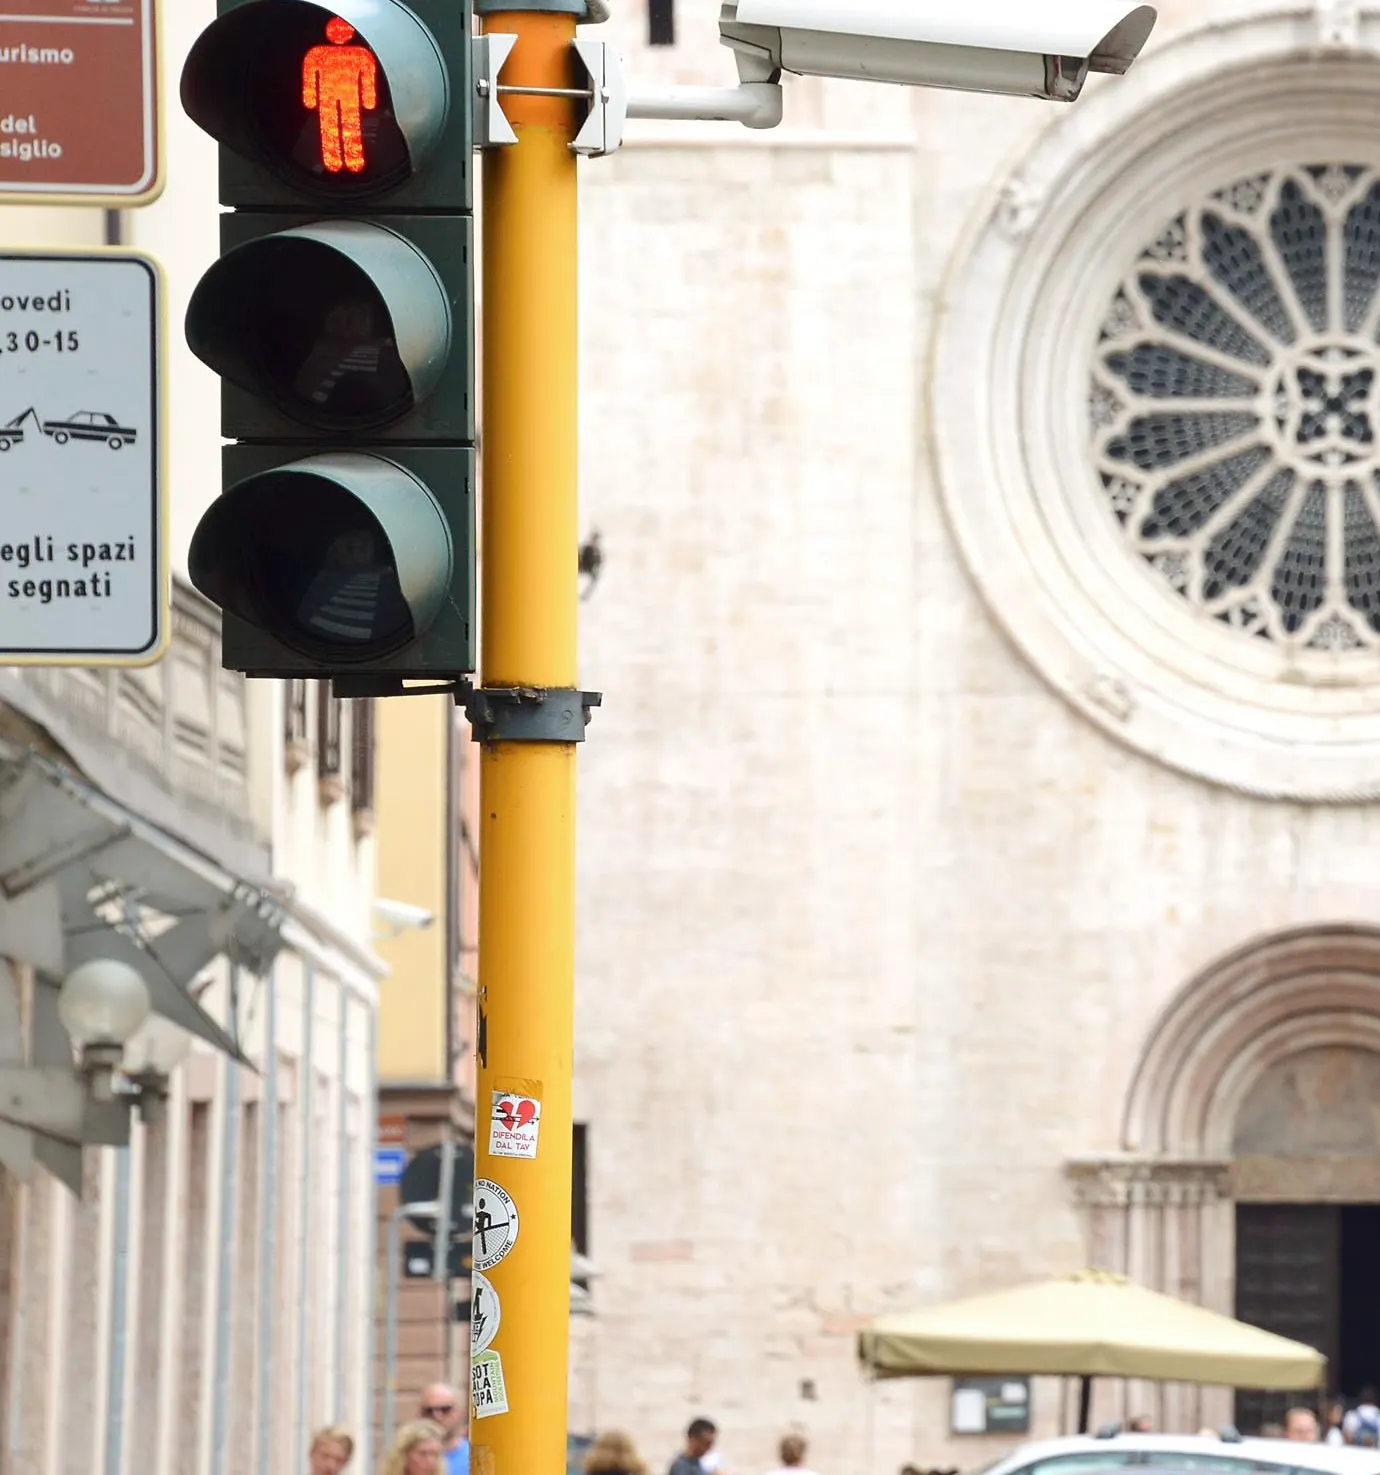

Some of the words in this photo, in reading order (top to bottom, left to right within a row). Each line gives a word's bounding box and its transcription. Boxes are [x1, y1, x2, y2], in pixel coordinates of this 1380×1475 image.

[0, 114, 37, 134] del
[1, 288, 70, 312] ovedi
[1, 535, 53, 568] egli
[67, 535, 135, 568] spazi
[8, 571, 111, 604] segnati
[495, 1141, 513, 1150] DAL
[485, 1181, 511, 1204] NATION
[482, 1239, 514, 1269] WELCOME
